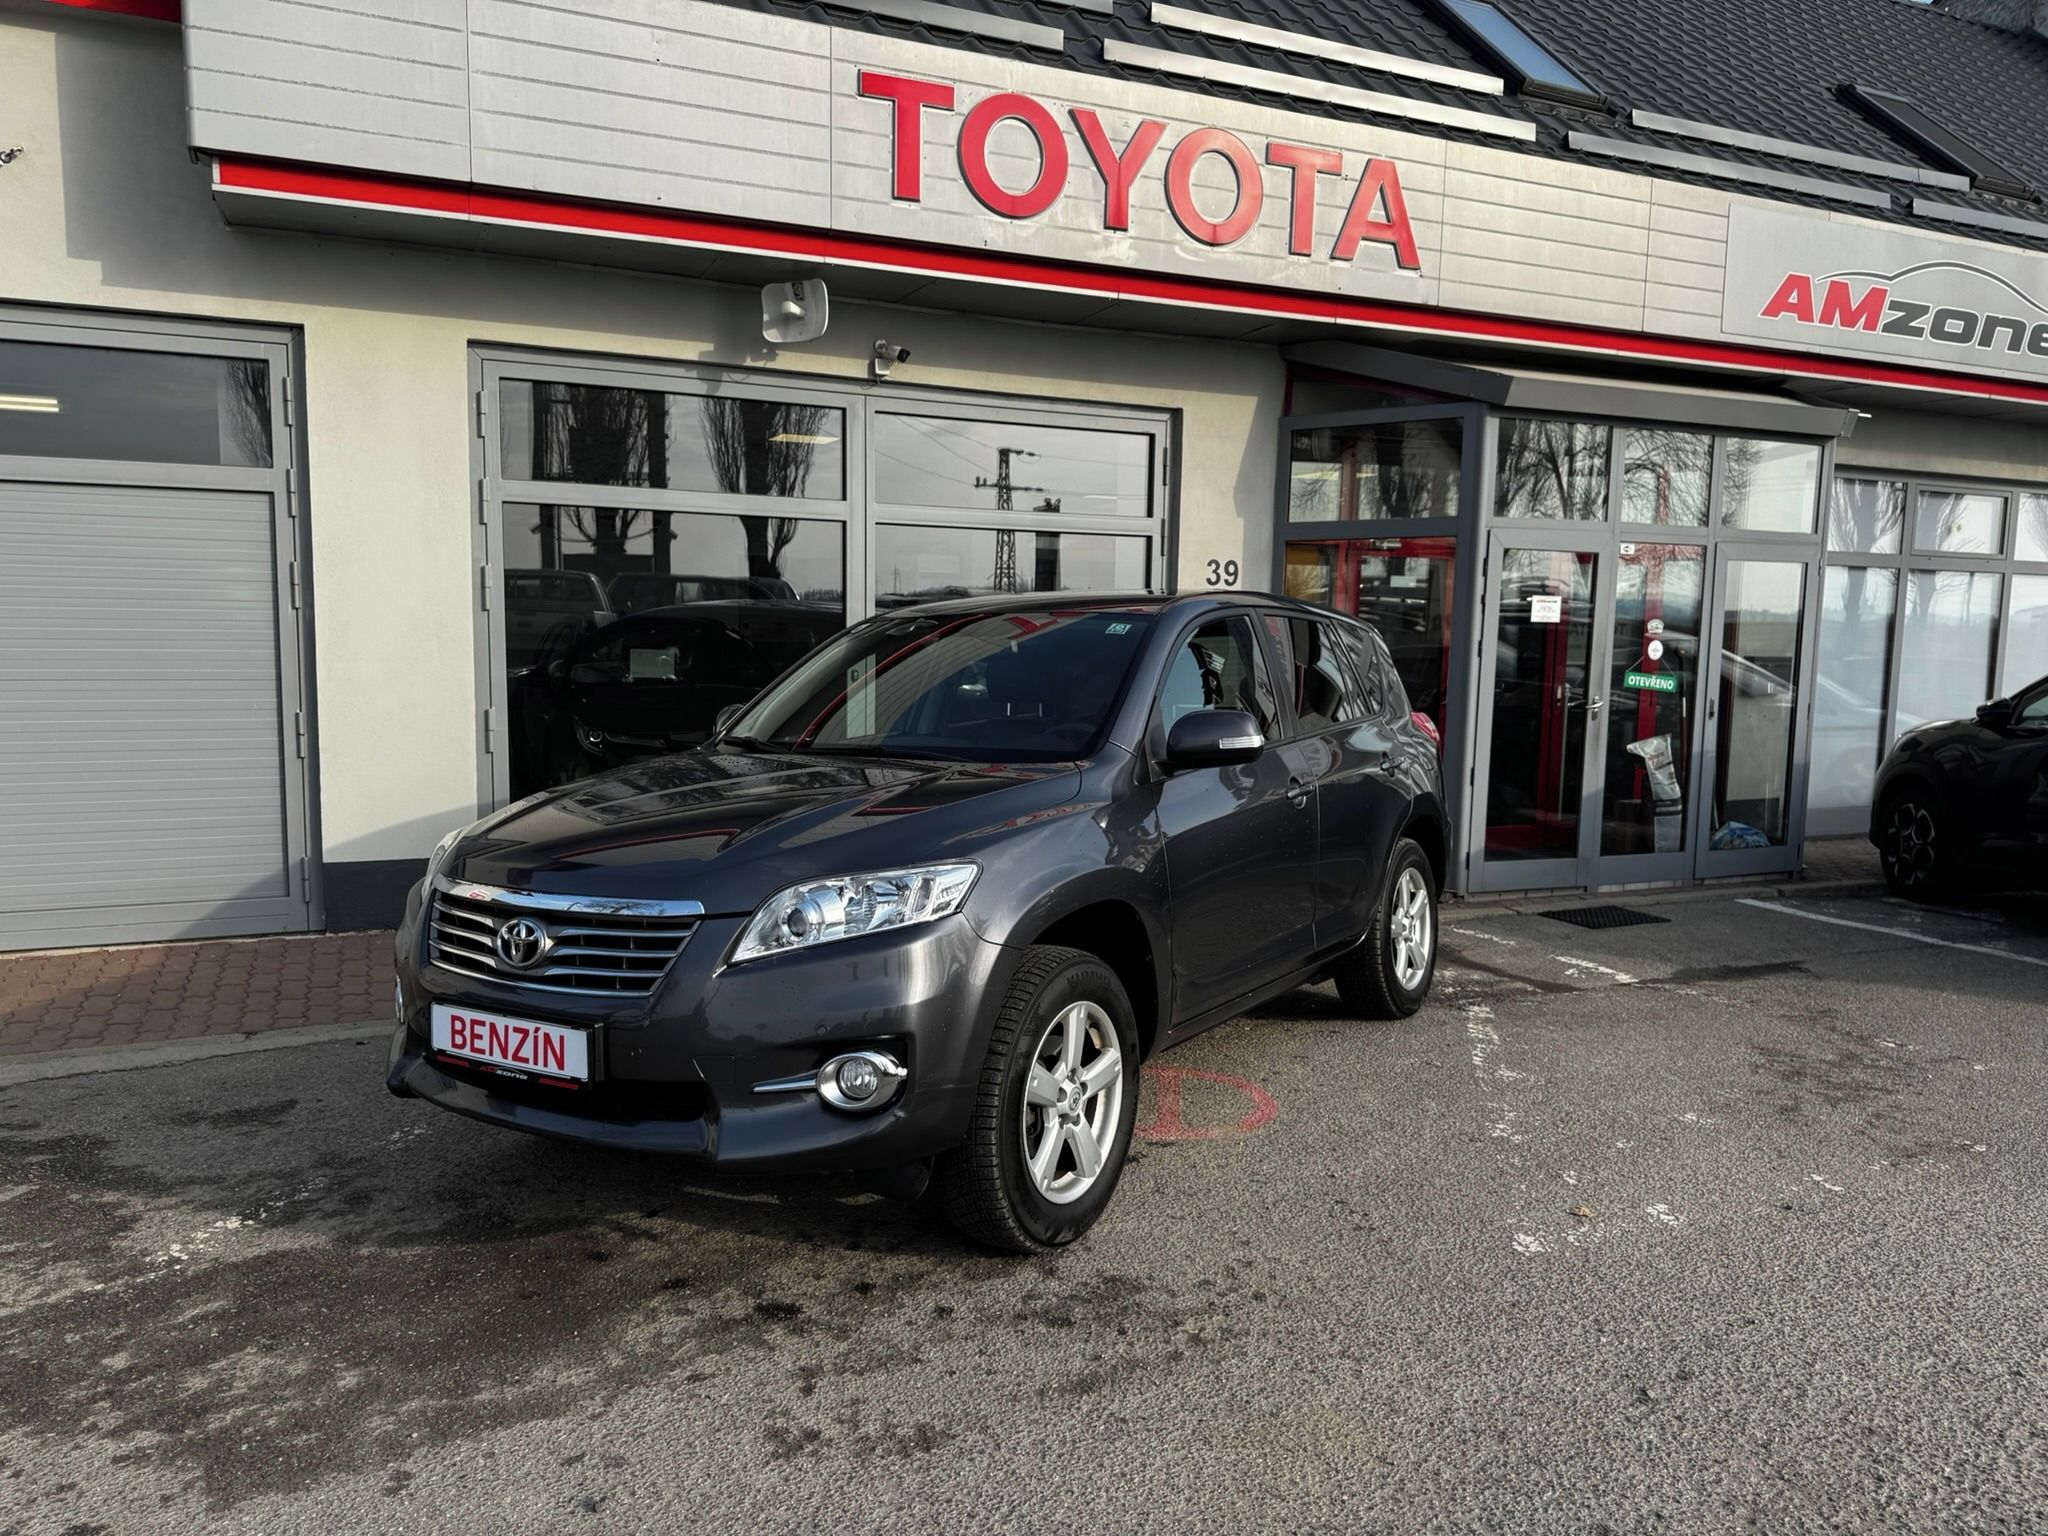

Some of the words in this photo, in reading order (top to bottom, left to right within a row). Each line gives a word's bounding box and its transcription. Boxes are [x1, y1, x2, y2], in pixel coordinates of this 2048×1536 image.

[858, 71, 1421, 270] TOYOTA
[1206, 559, 1239, 587] 39
[1628, 675, 1674, 690] OTEVŘENO
[450, 1014, 565, 1071] BENZÍN
